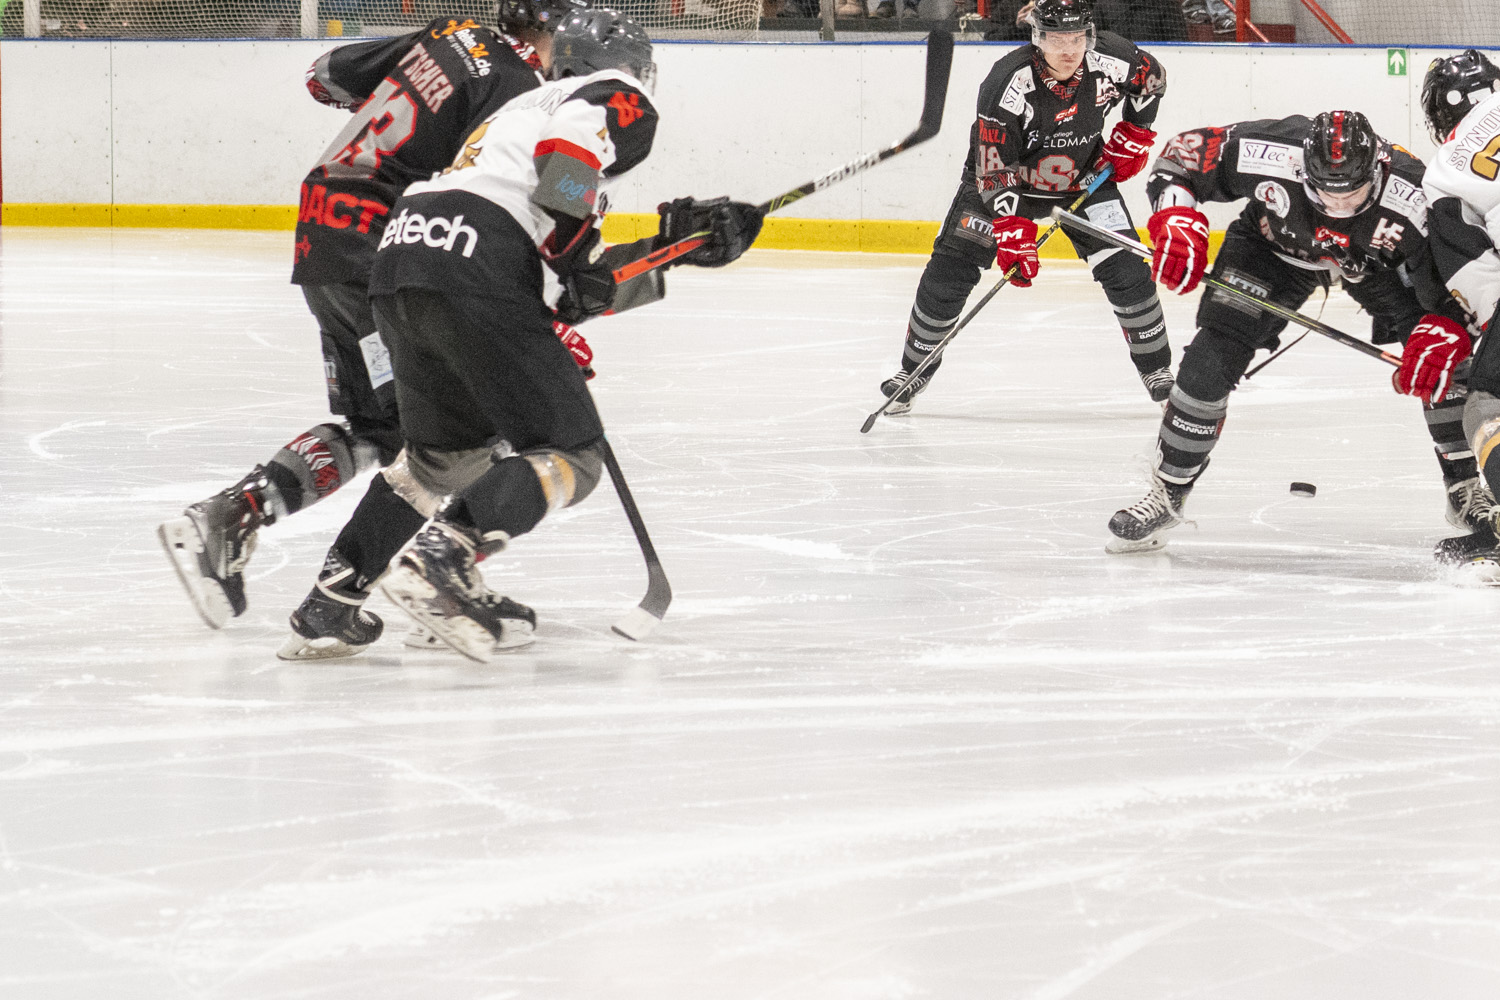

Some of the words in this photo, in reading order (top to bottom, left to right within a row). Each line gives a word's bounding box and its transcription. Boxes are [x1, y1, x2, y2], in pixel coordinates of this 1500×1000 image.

[454, 28, 492, 76] Reifen24.de
[397, 42, 454, 114] TSCHER
[1243, 141, 1289, 163] SiTec
[377, 208, 478, 258] etech
[1229, 275, 1268, 298] KTM
[1172, 419, 1214, 435] BANNAT
[1173, 415, 1215, 430] FAHRSCHULE
